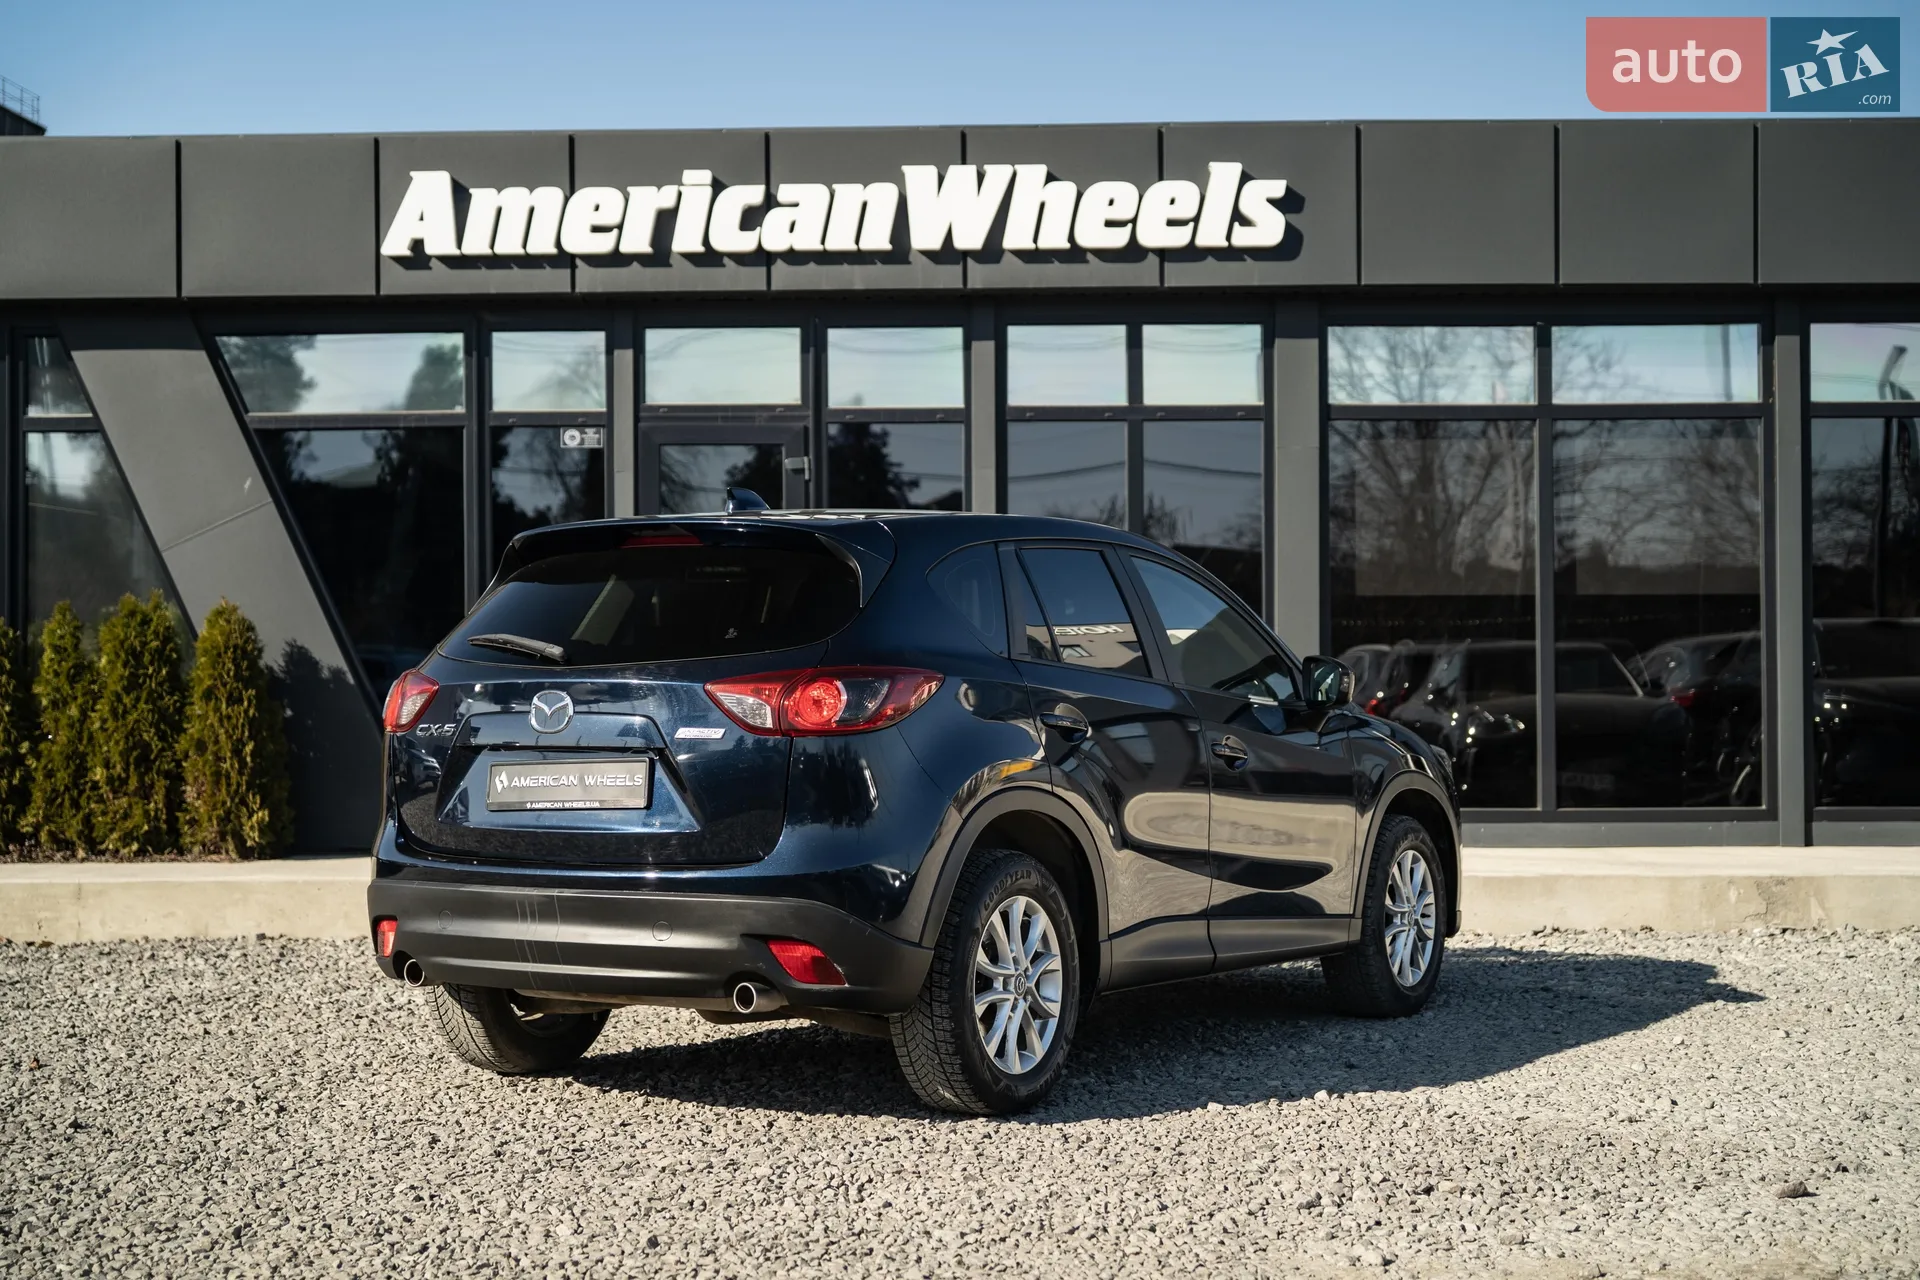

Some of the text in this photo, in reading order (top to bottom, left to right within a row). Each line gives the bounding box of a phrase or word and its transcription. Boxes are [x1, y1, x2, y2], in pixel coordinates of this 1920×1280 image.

[380, 161, 1289, 257] AmericanWheels
[416, 723, 456, 737] CX-5
[510, 774, 643, 788] AMERICAN WHEELS
[983, 869, 1033, 911] GOODYEAR
